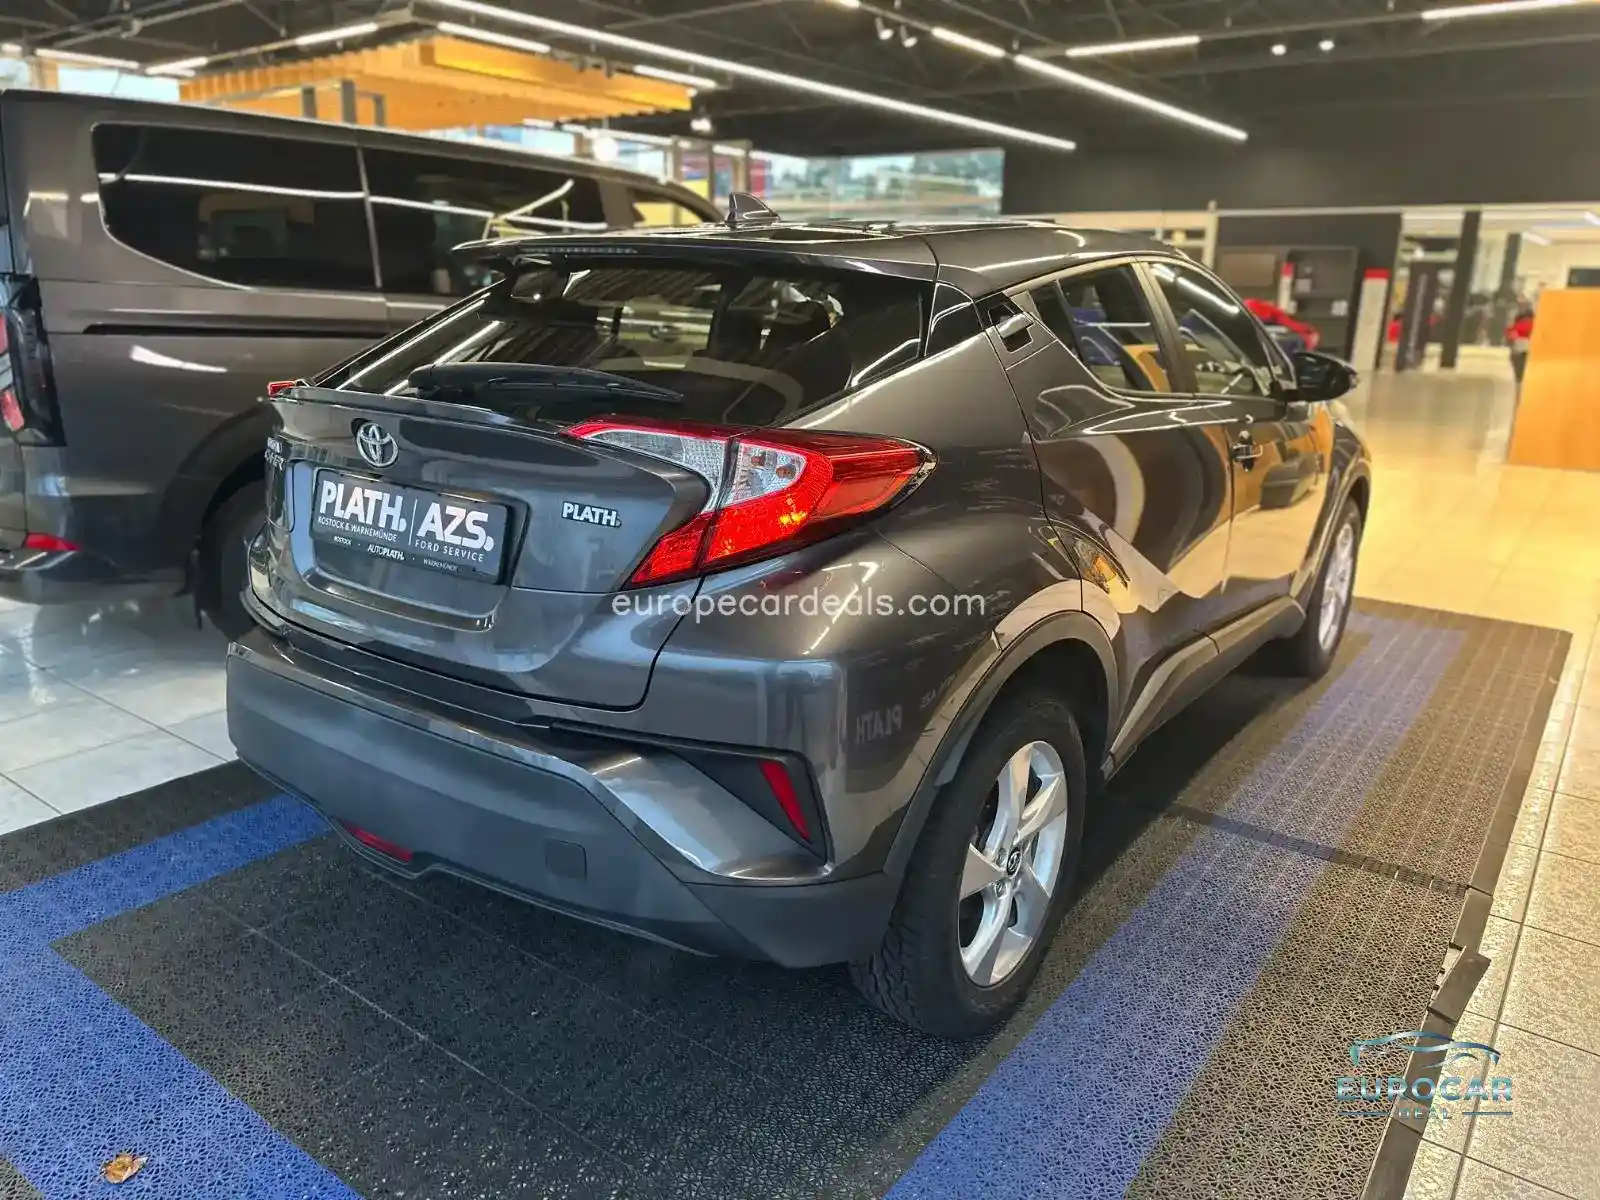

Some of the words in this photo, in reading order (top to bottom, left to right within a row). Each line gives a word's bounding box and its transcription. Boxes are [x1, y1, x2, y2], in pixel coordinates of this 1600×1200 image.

[317, 516, 345, 529] ROSTOCK
[320, 480, 407, 532] PLATH.
[416, 502, 495, 551] AZS.
[415, 539, 440, 552] FORD
[443, 545, 485, 562] SERVICE
